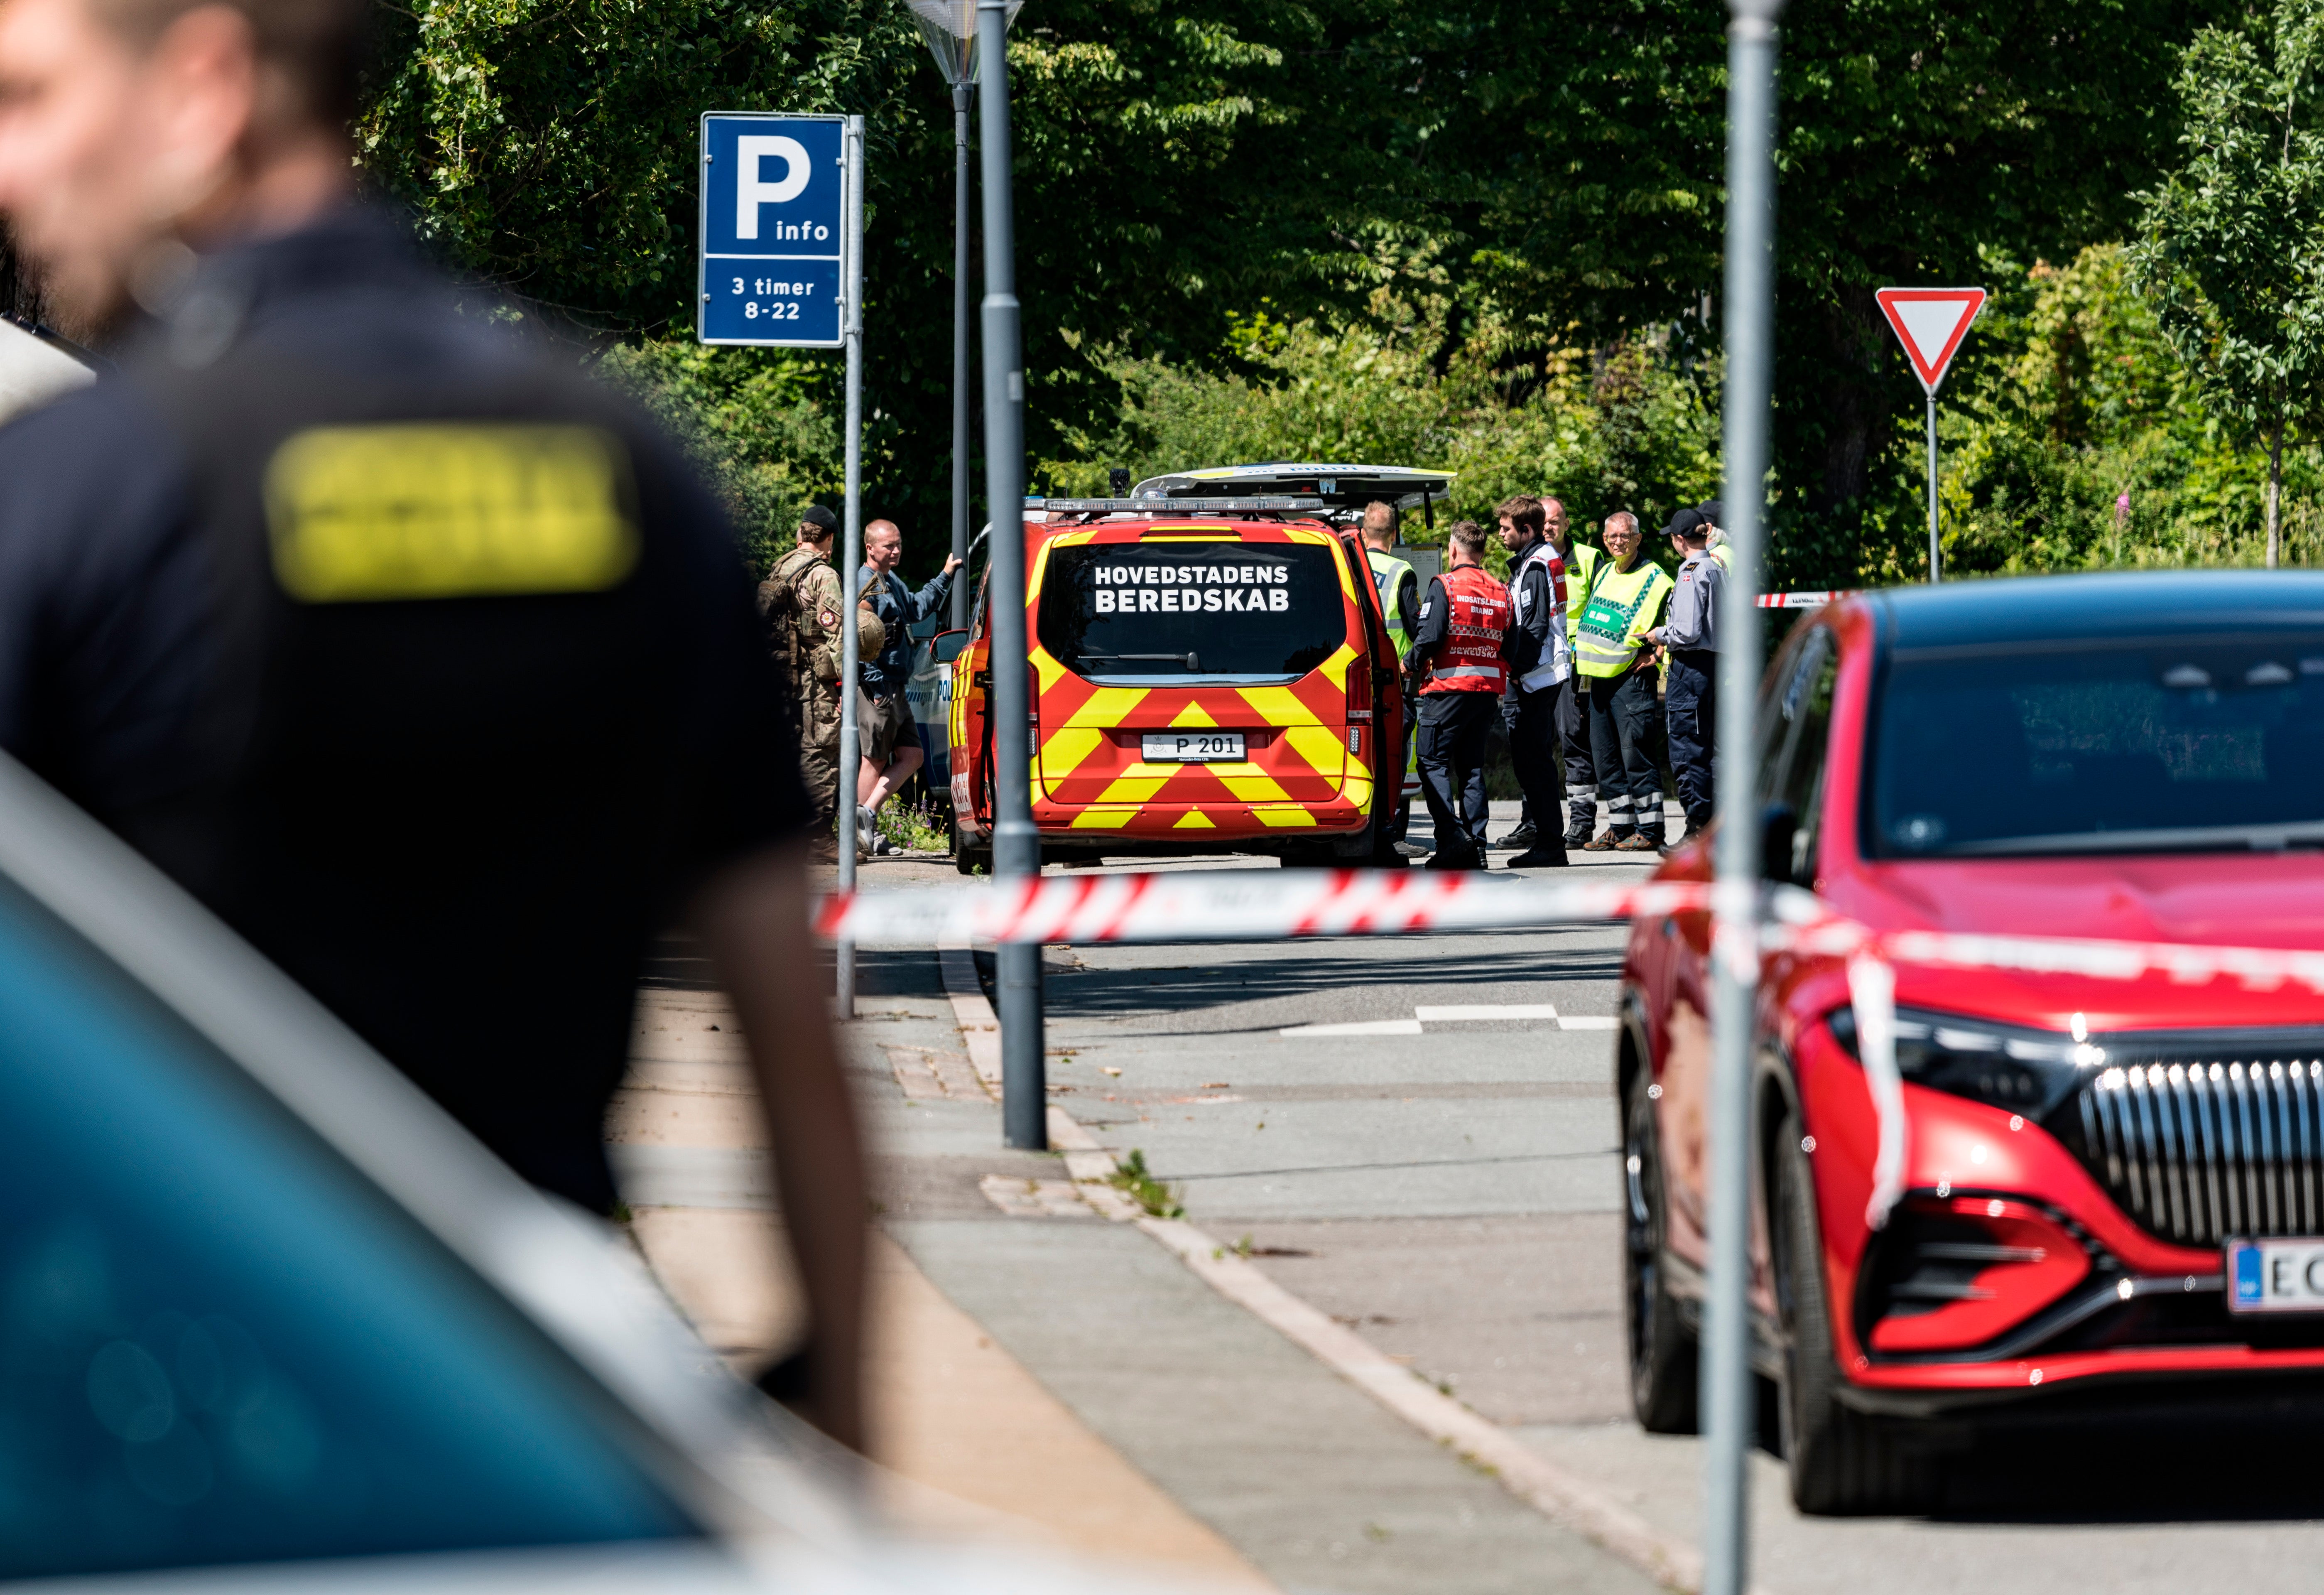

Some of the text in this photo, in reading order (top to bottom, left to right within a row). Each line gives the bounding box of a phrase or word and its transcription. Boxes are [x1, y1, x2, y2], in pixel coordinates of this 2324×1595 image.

[736, 135, 829, 240] P info
[731, 277, 814, 296] 3 timer
[745, 302, 800, 320] 8-22
[1095, 566, 1288, 584] HOVEDSTADENS
[1095, 589, 1289, 613] BEREDSKAB
[1456, 595, 1505, 608] INDSATSLEDER
[1471, 606, 1494, 615] BRAND
[1176, 737, 1236, 753] P 201
